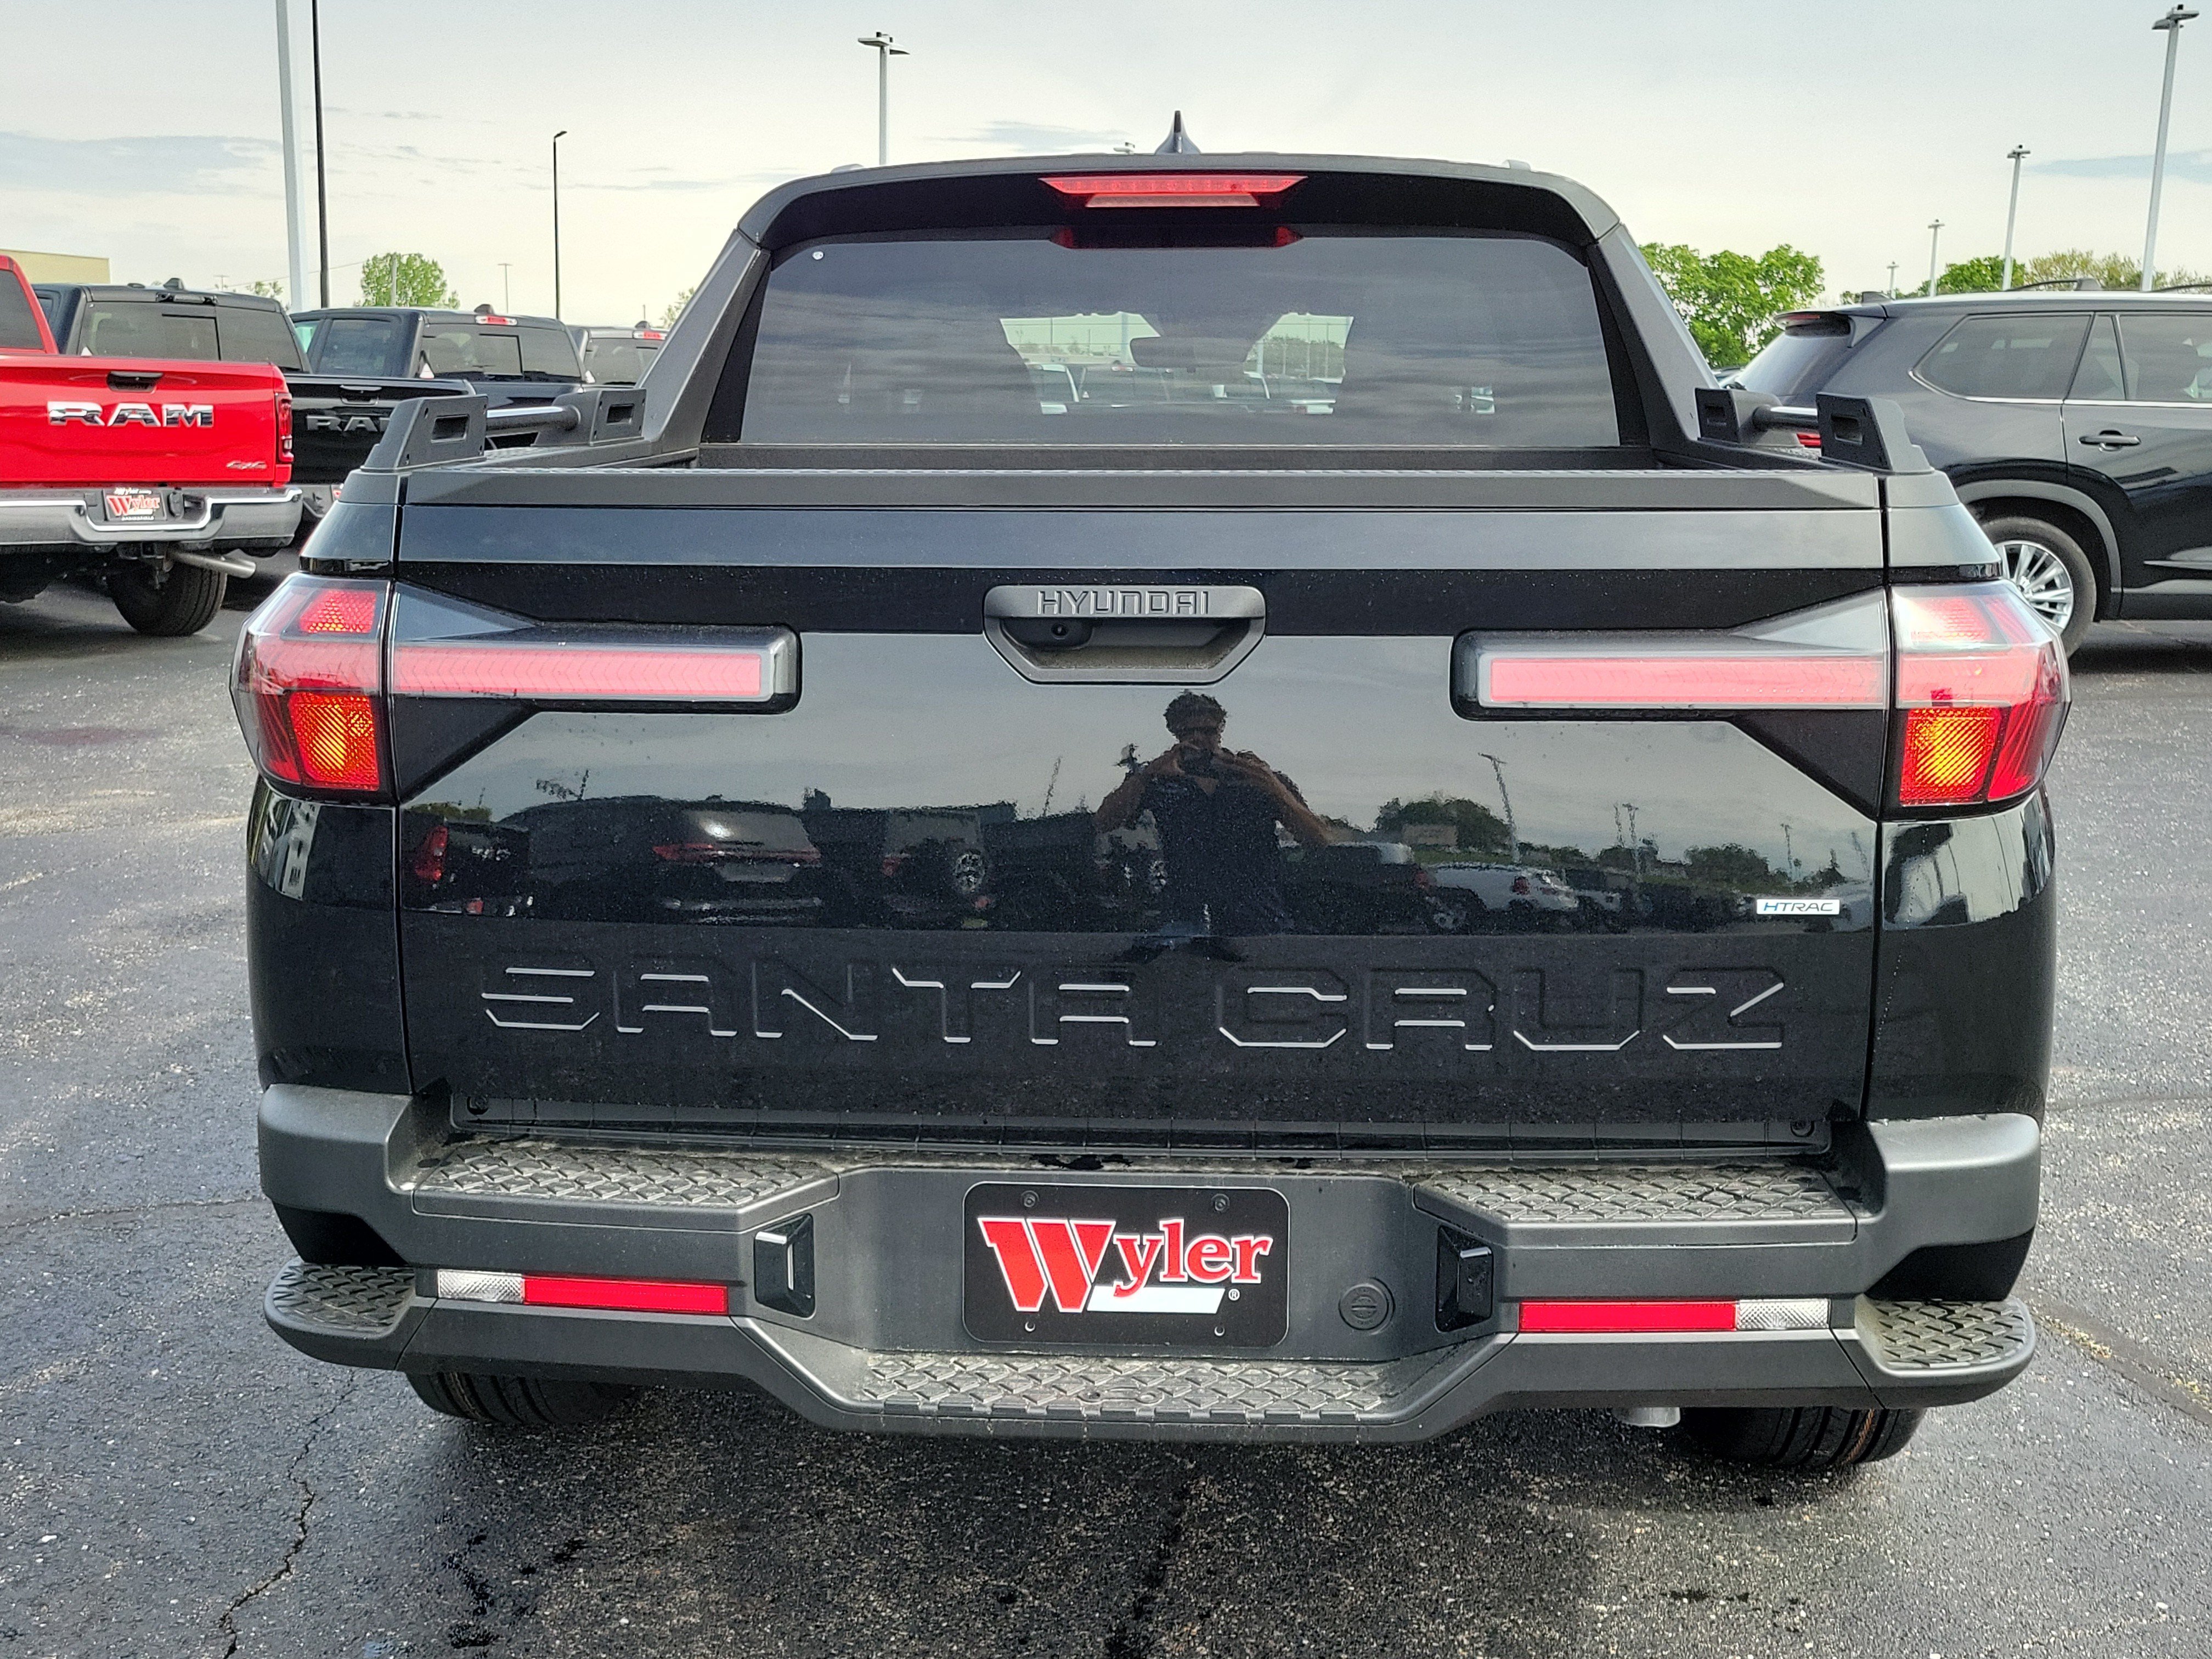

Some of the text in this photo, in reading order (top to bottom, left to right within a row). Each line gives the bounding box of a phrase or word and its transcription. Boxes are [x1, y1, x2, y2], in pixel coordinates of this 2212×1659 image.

[47, 401, 213, 427] RAM
[106, 495, 160, 516] Wyler
[1037, 590, 1209, 615] HYUNDAI
[1763, 902, 1833, 912] HTRAC
[481, 953, 1785, 1051] SANTA CRUZ
[977, 1216, 1274, 1313] Wyler
